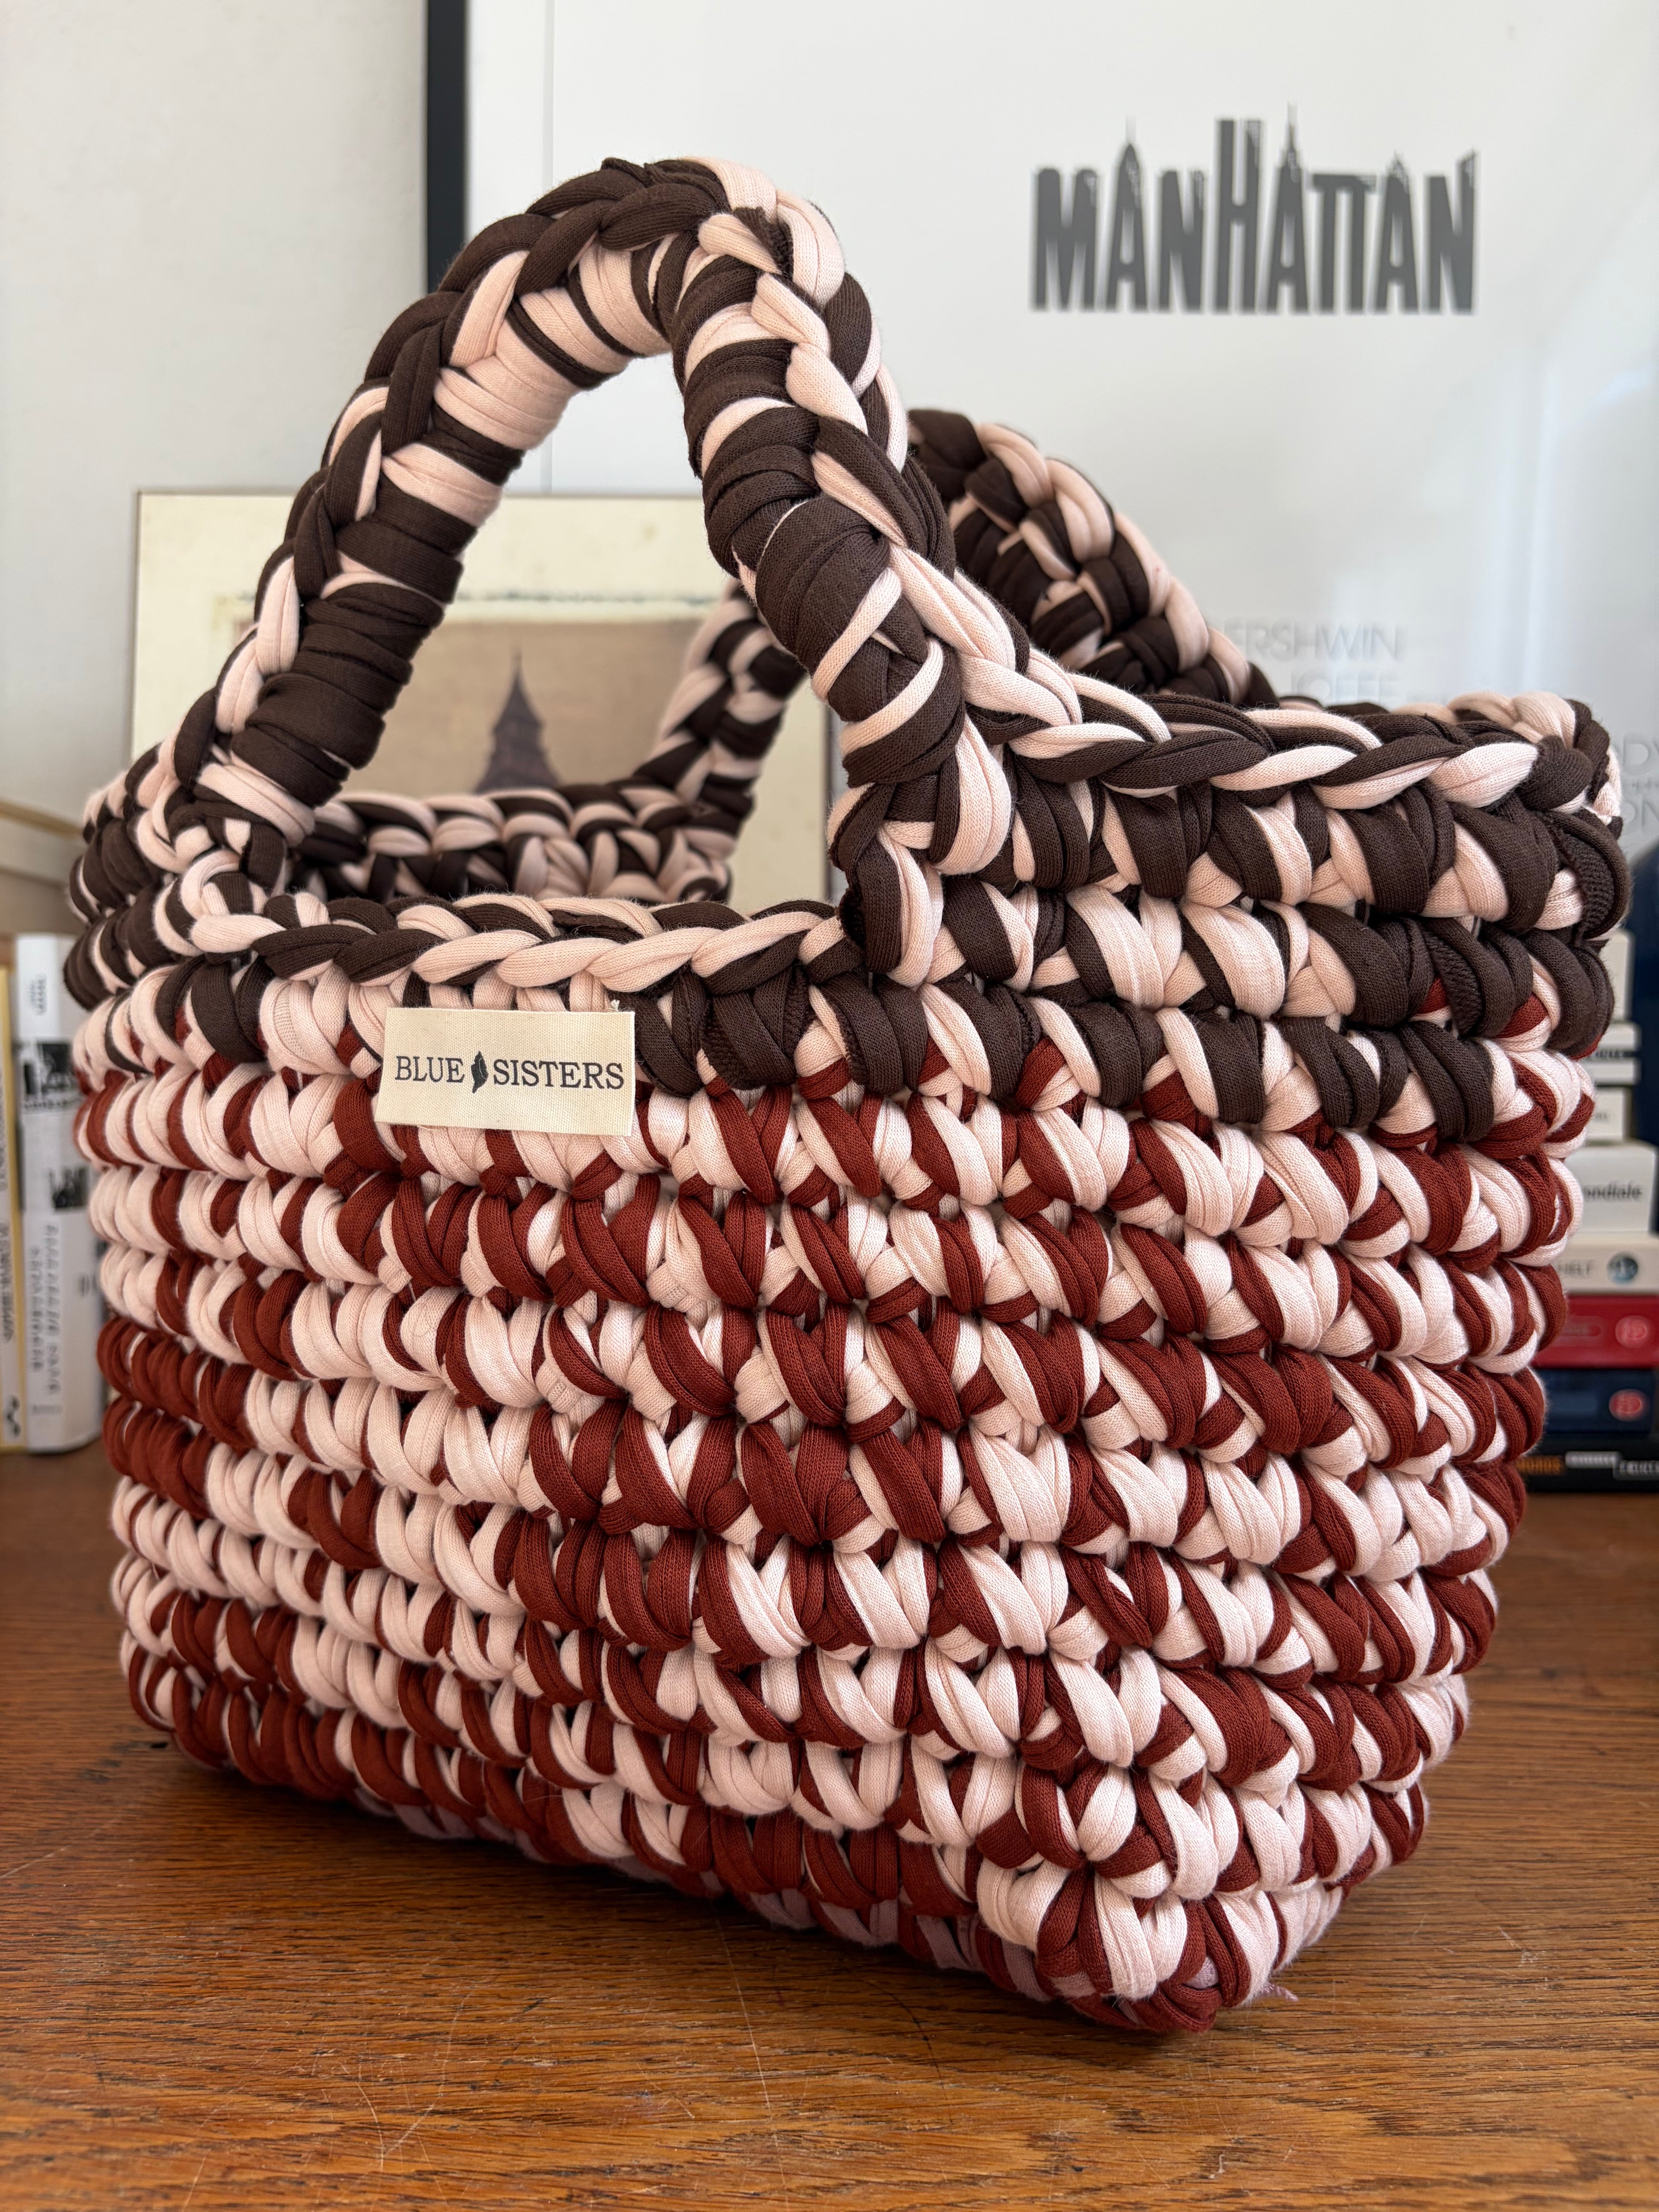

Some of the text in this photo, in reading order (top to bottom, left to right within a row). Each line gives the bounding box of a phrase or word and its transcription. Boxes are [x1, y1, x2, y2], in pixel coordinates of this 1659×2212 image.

[1032, 104, 1476, 314] MANHATTAN
[1223, 619, 1408, 664] ERSHWIN
[395, 1055, 624, 1090] BLUE SISTERS
[1583, 1182, 1641, 1201] ondiale
